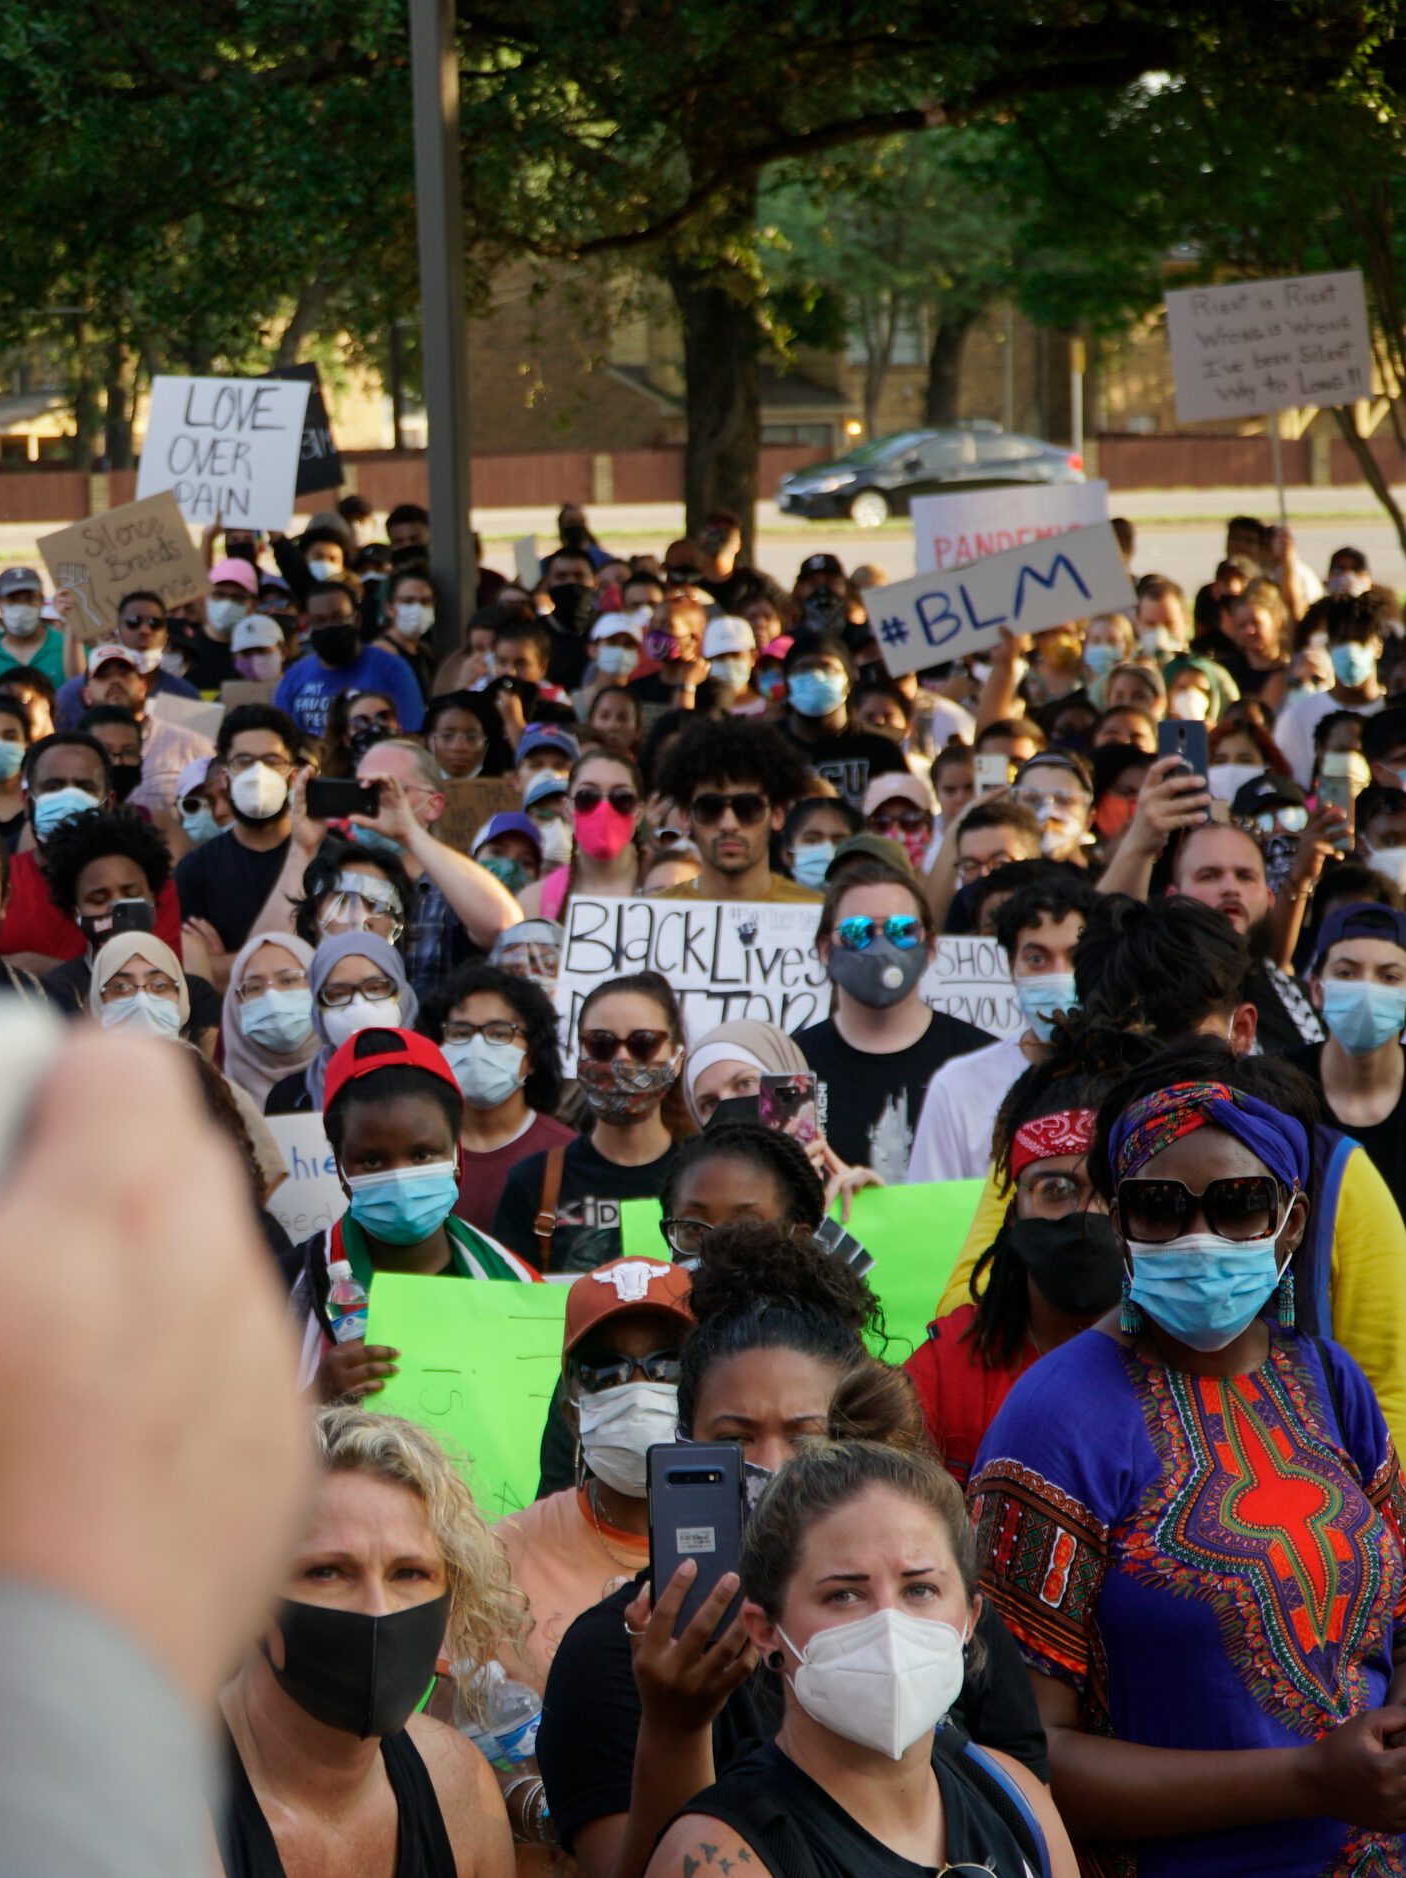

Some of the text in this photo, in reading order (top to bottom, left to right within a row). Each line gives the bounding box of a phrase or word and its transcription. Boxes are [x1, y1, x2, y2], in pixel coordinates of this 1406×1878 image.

[185, 384, 286, 431] LOVE
[168, 434, 253, 481] OVER
[175, 480, 251, 516] PAIN
[934, 523, 1082, 569] PANDE
[880, 553, 1092, 647] #BLM
[565, 901, 828, 987] Black Lives
[935, 941, 1011, 978] SHOU
